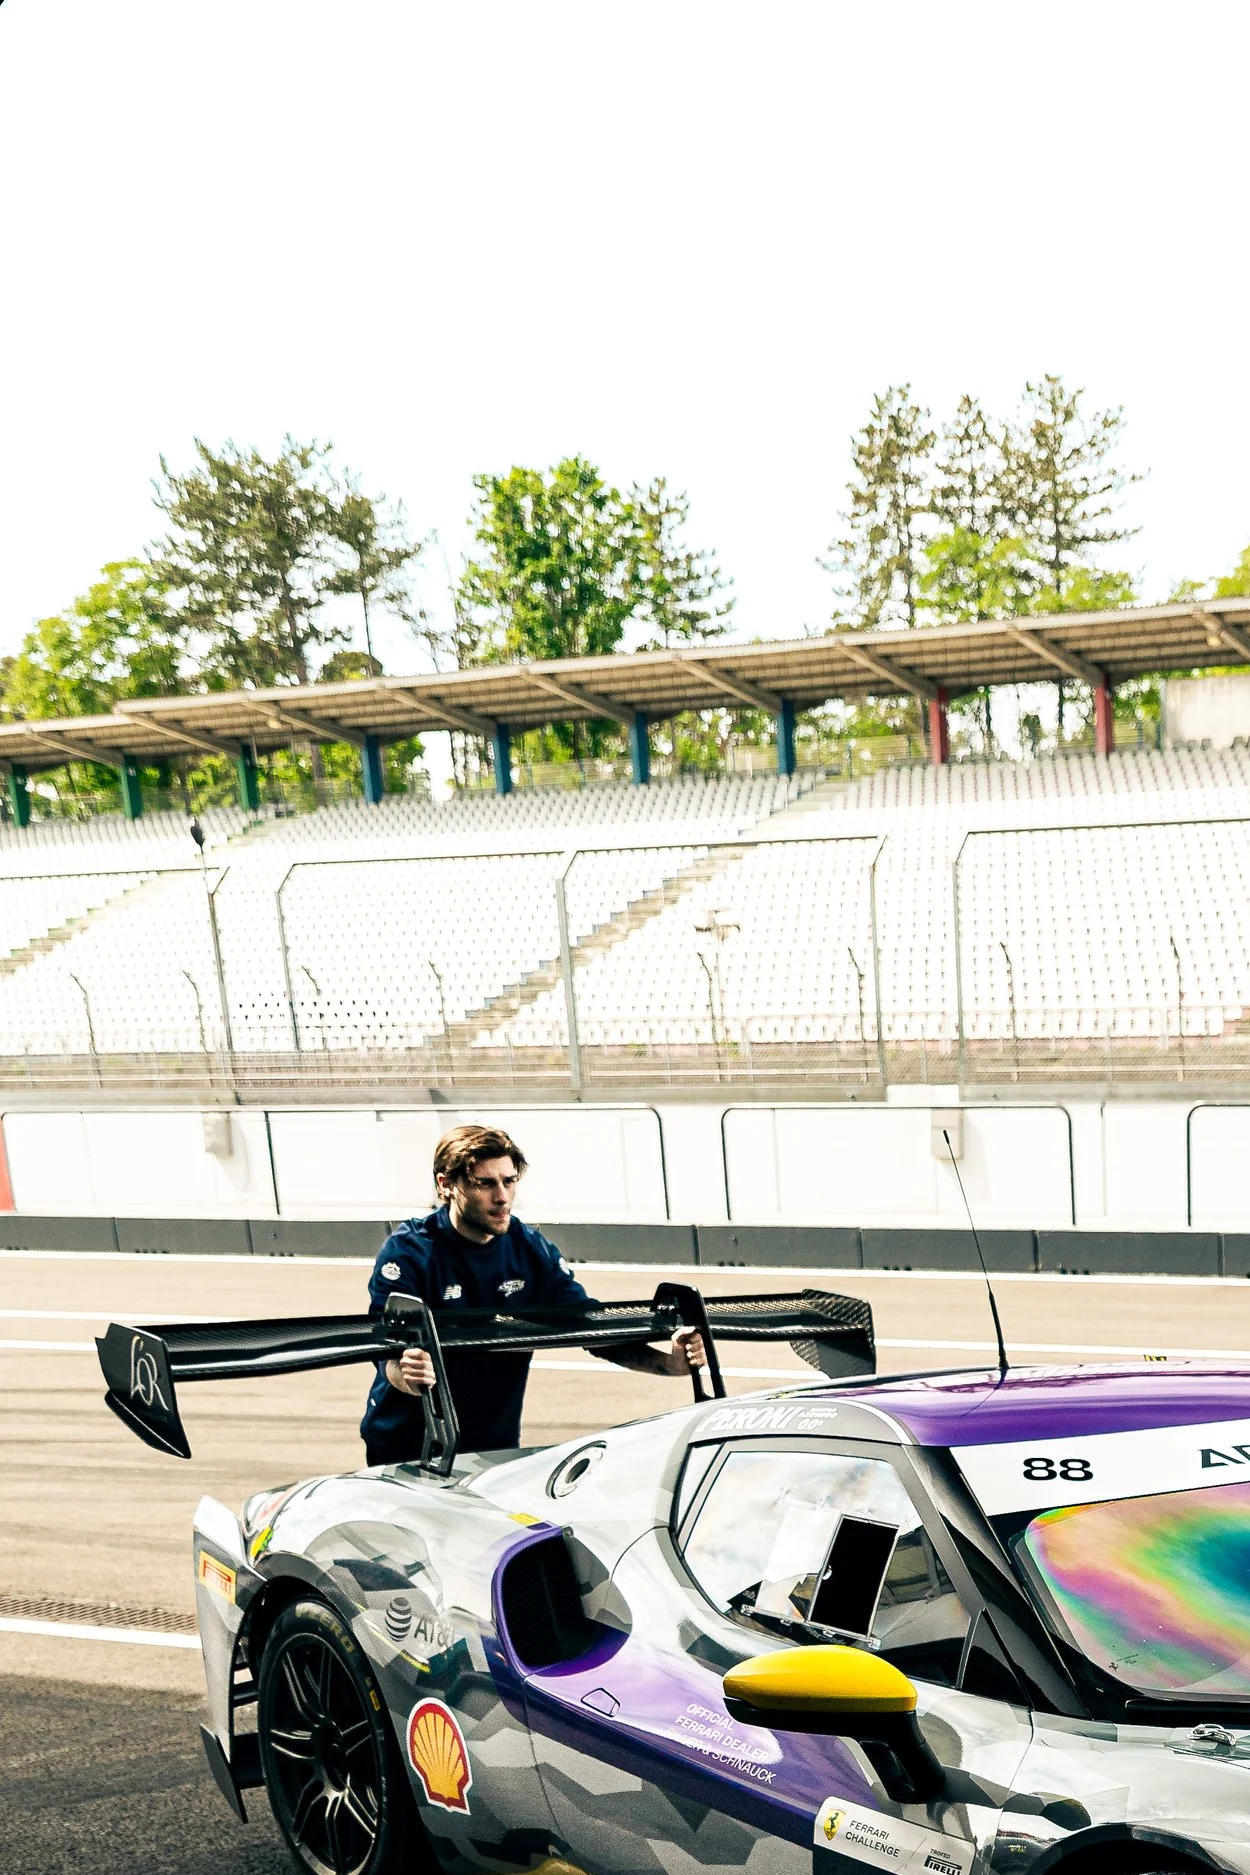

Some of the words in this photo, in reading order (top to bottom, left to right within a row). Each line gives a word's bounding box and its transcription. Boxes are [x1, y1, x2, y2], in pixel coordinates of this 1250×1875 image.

[696, 1406, 806, 1432] PERONI
[1023, 1457, 1094, 1482] 88
[686, 1703, 734, 1731] OFFICIAL
[675, 1715, 723, 1743] FERRARI
[722, 1735, 770, 1763] DEALER
[711, 1748, 777, 1784] SCHNAUCK
[850, 1820, 891, 1841] FERRARI
[845, 1831, 900, 1858] CHALLENGE
[930, 1848, 951, 1859] TROFEO
